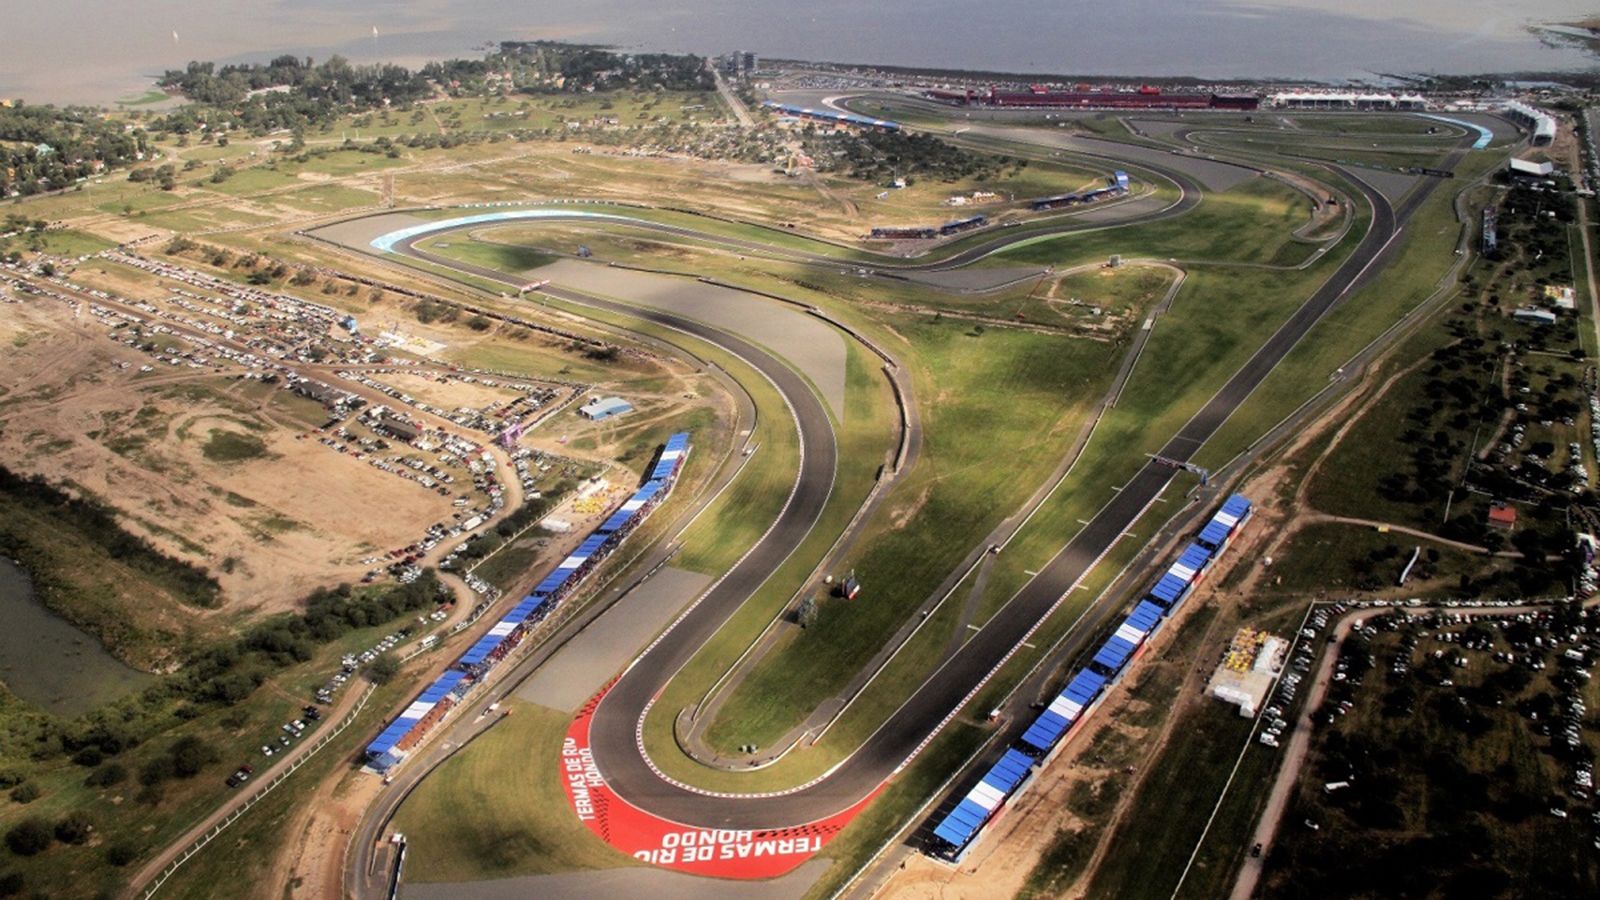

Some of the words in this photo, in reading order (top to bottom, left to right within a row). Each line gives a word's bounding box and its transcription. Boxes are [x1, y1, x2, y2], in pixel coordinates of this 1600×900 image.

[564, 757, 583, 772] DE
[578, 747, 604, 787] HONDO
[568, 773, 595, 820] TERMAS
[662, 829, 753, 849] HONDO
[720, 836, 822, 859] TERMAS
[682, 845, 713, 863] DE
